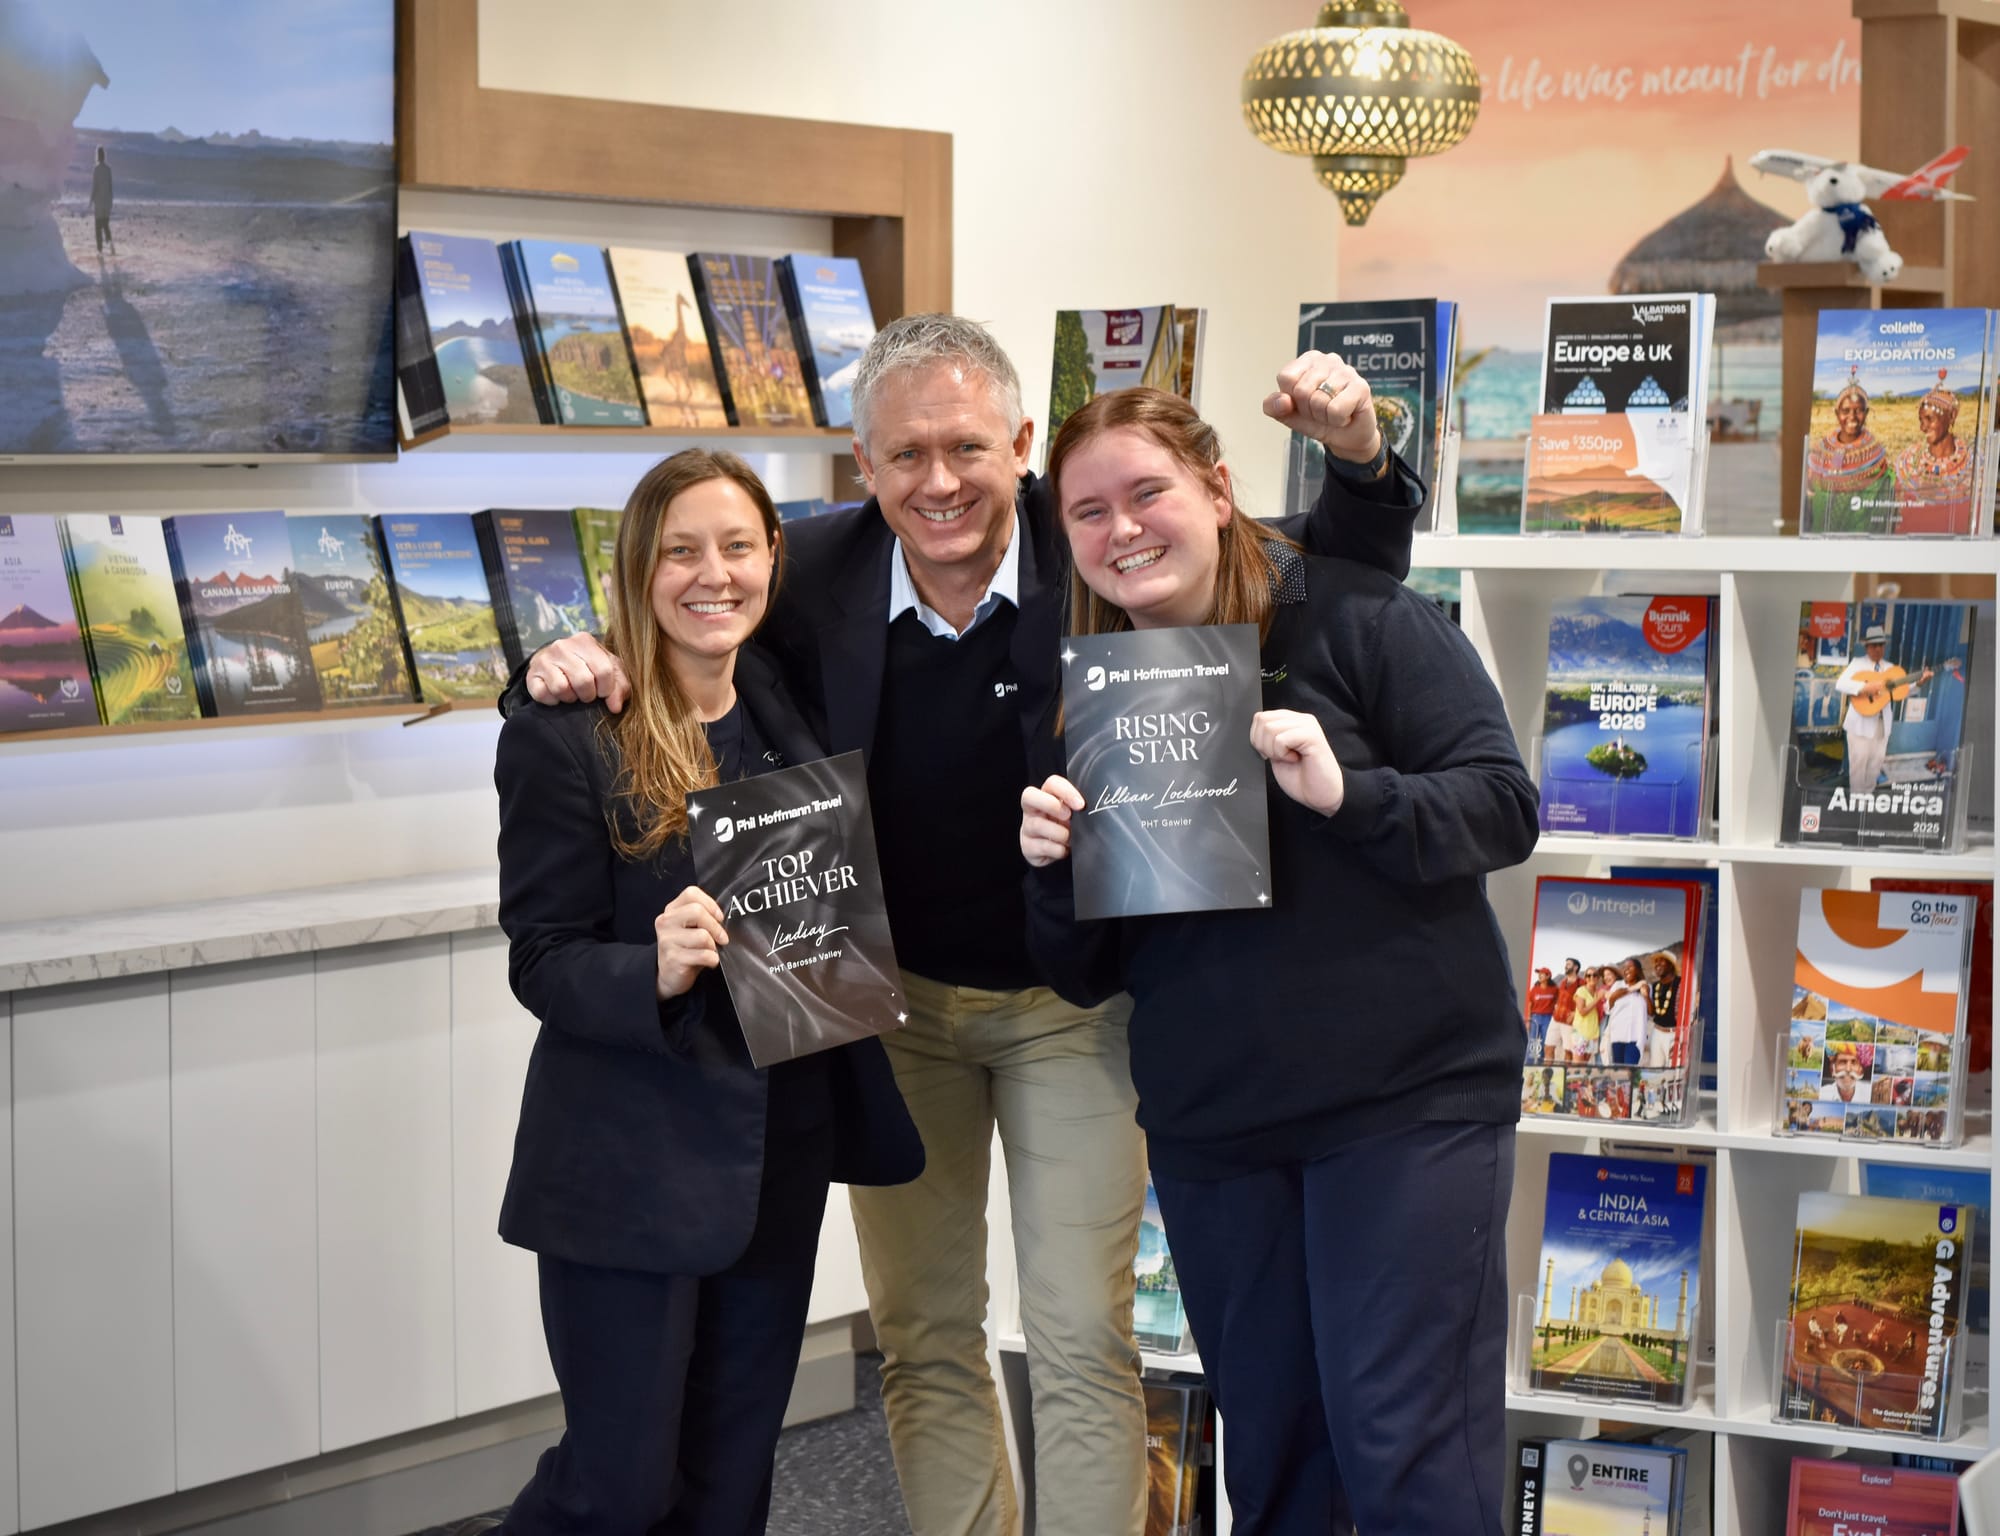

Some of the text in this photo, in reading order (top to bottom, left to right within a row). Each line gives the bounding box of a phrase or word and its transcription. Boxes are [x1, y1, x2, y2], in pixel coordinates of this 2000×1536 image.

[1500, 57, 1556, 110] life
[1562, 67, 1633, 99] was
[1641, 42, 1748, 97] meant
[1758, 47, 1808, 98] for
[1638, 304, 1687, 314] ALBATROSS
[1880, 321, 1925, 334] collette
[1343, 334, 1394, 345] BEYOND
[1346, 352, 1426, 371] LECTION
[1554, 341, 1672, 367] Europe & UK
[1844, 348, 1956, 361] EXPLORATIONS
[1538, 434, 1623, 453] Save $350pp
[201, 587, 233, 598] CANADA
[242, 585, 272, 597] ALASKA
[1649, 610, 1690, 622] Bunnik
[1109, 663, 1229, 683] Phil Hoffmann Travel
[1590, 694, 1657, 712] EUROPE
[1114, 711, 1210, 740] RISING
[1599, 712, 1646, 731] 2026
[1128, 738, 1200, 766] STAR
[1088, 778, 1238, 815] Lillian Lockwood
[1827, 787, 1944, 816] America
[735, 794, 843, 833] Phil Hoffmann Travel
[1141, 817, 1193, 829] PHT Gawler
[762, 849, 814, 882] TOP
[727, 864, 858, 919] ACHIEVER
[1591, 896, 1656, 917] Intrepid
[1912, 900, 1958, 914] On the
[1911, 912, 1930, 924] Go
[766, 920, 849, 957] Lindsay
[769, 949, 843, 975] PHT Barossa Valley
[1599, 1192, 1648, 1212] INDIA
[1578, 1208, 1670, 1228] & CENTRAL ASIA
[1921, 1239, 1955, 1410] G Adventures
[1146, 1435, 1163, 1448] ENT
[1592, 1464, 1649, 1483] ENTIRE
[1521, 1479, 1536, 1536] RNEYS
[1818, 1507, 1888, 1526] Don't just travel,
